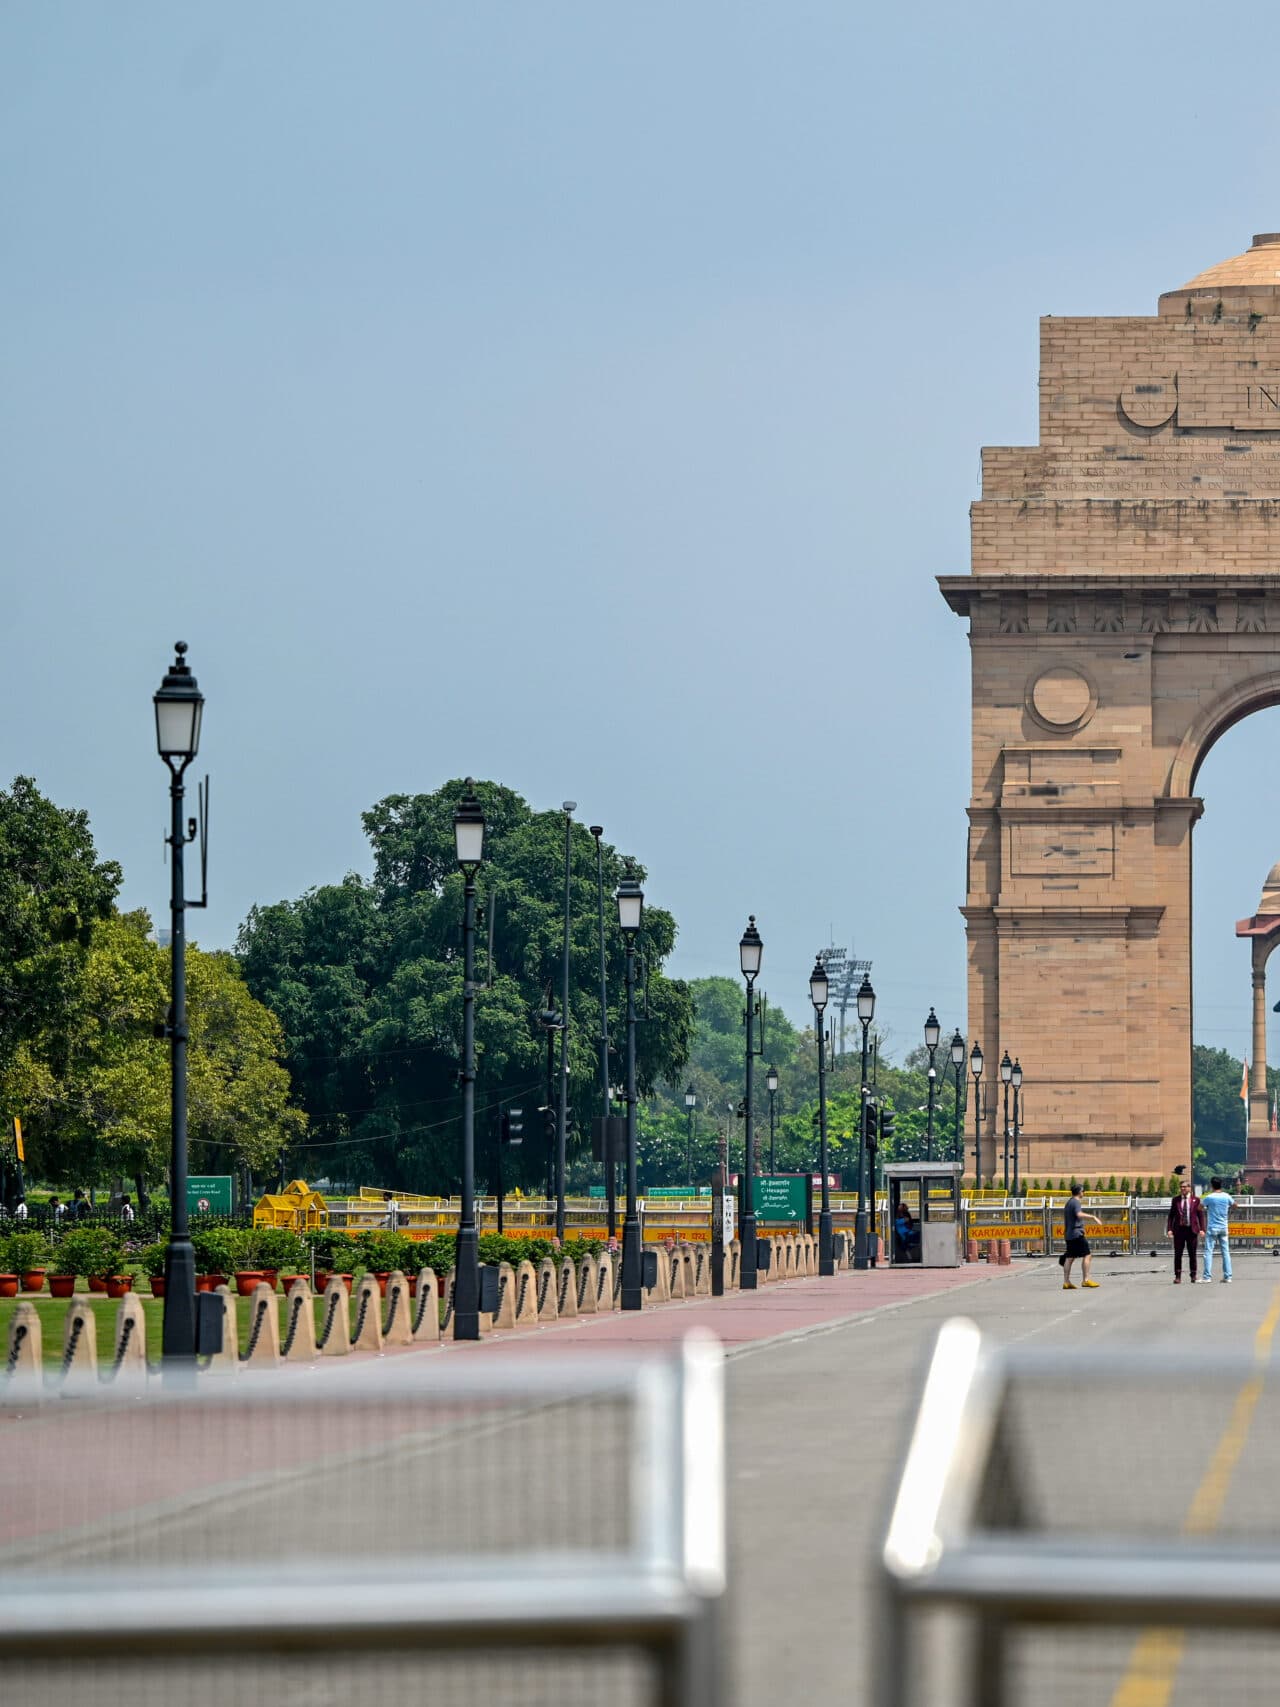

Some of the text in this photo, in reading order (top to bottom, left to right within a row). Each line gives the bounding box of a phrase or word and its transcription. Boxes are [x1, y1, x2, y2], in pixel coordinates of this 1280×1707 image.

[971, 1227, 1041, 1238] KARTAVYA PATH
[1103, 1226, 1126, 1235] PATH
